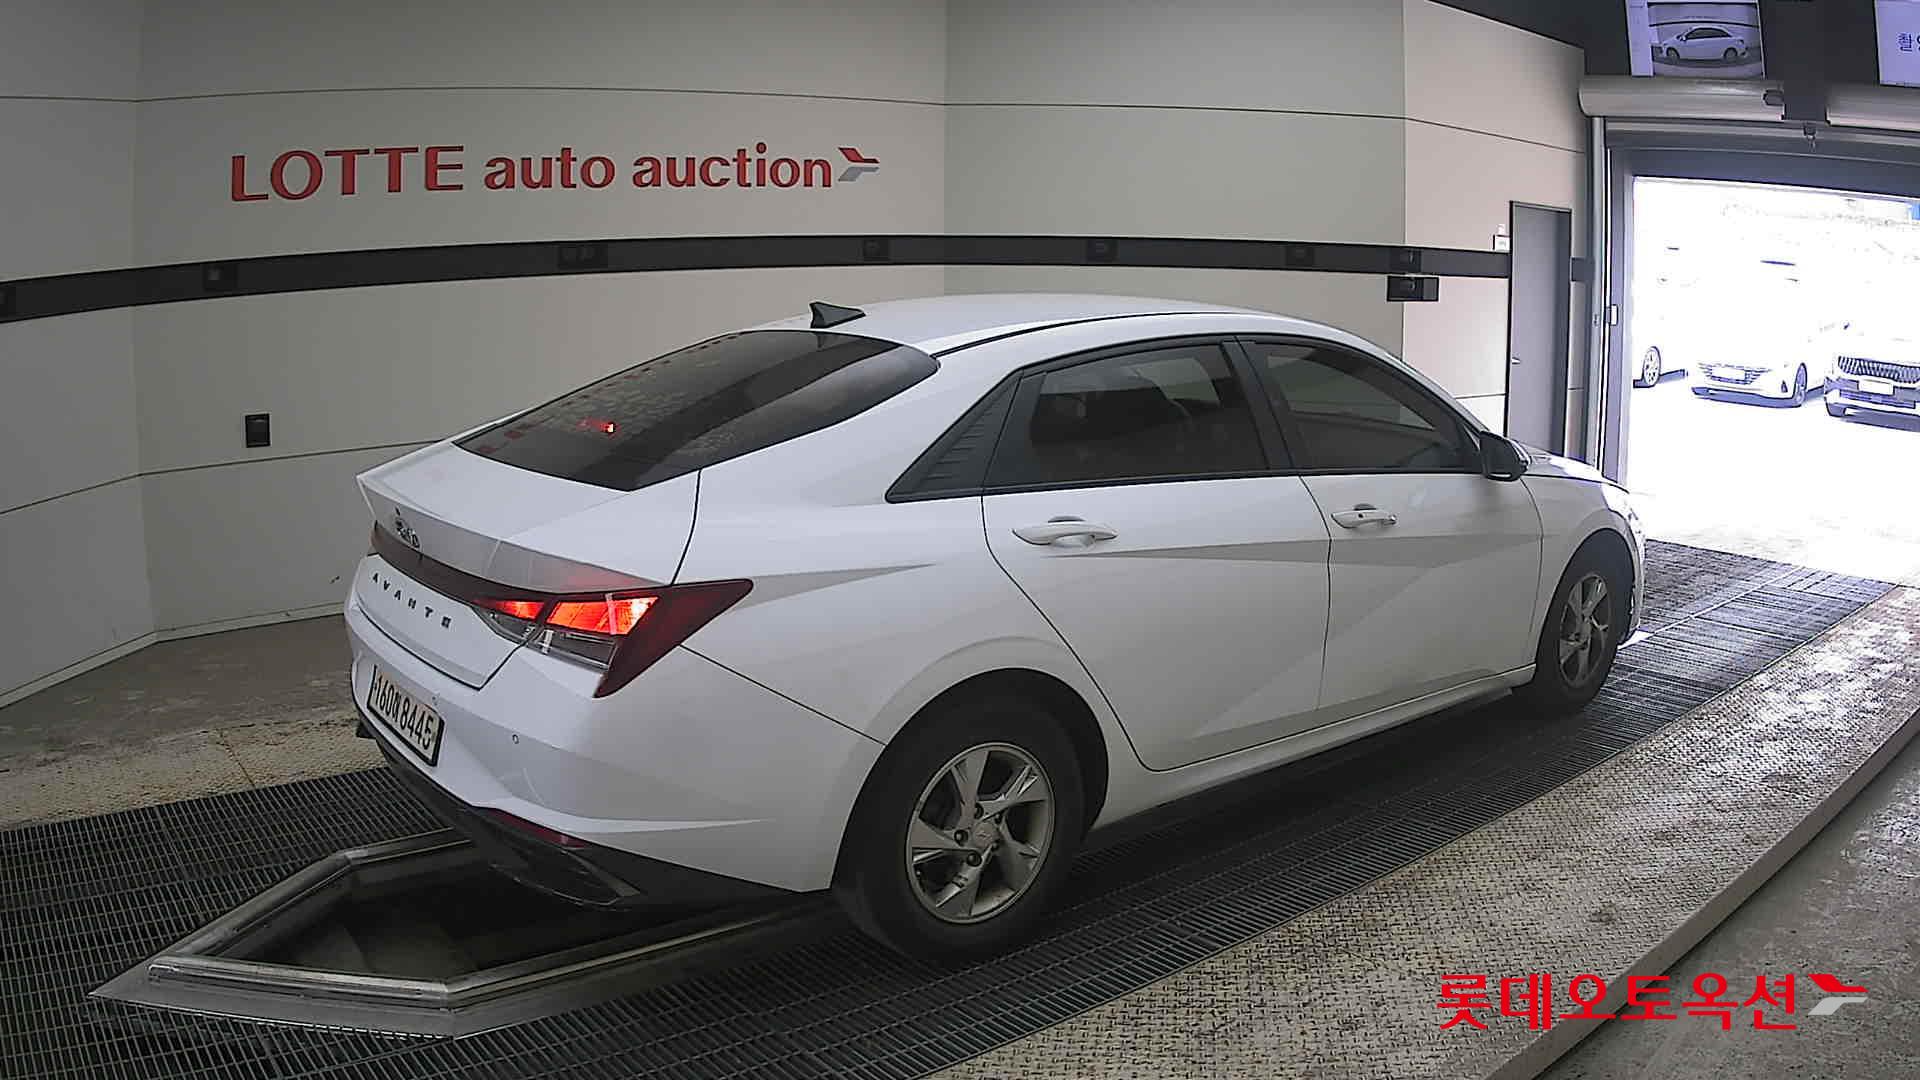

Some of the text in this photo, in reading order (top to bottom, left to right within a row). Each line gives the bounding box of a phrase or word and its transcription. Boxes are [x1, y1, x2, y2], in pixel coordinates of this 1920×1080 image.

[232, 143, 832, 201] LOTTE auto auction
